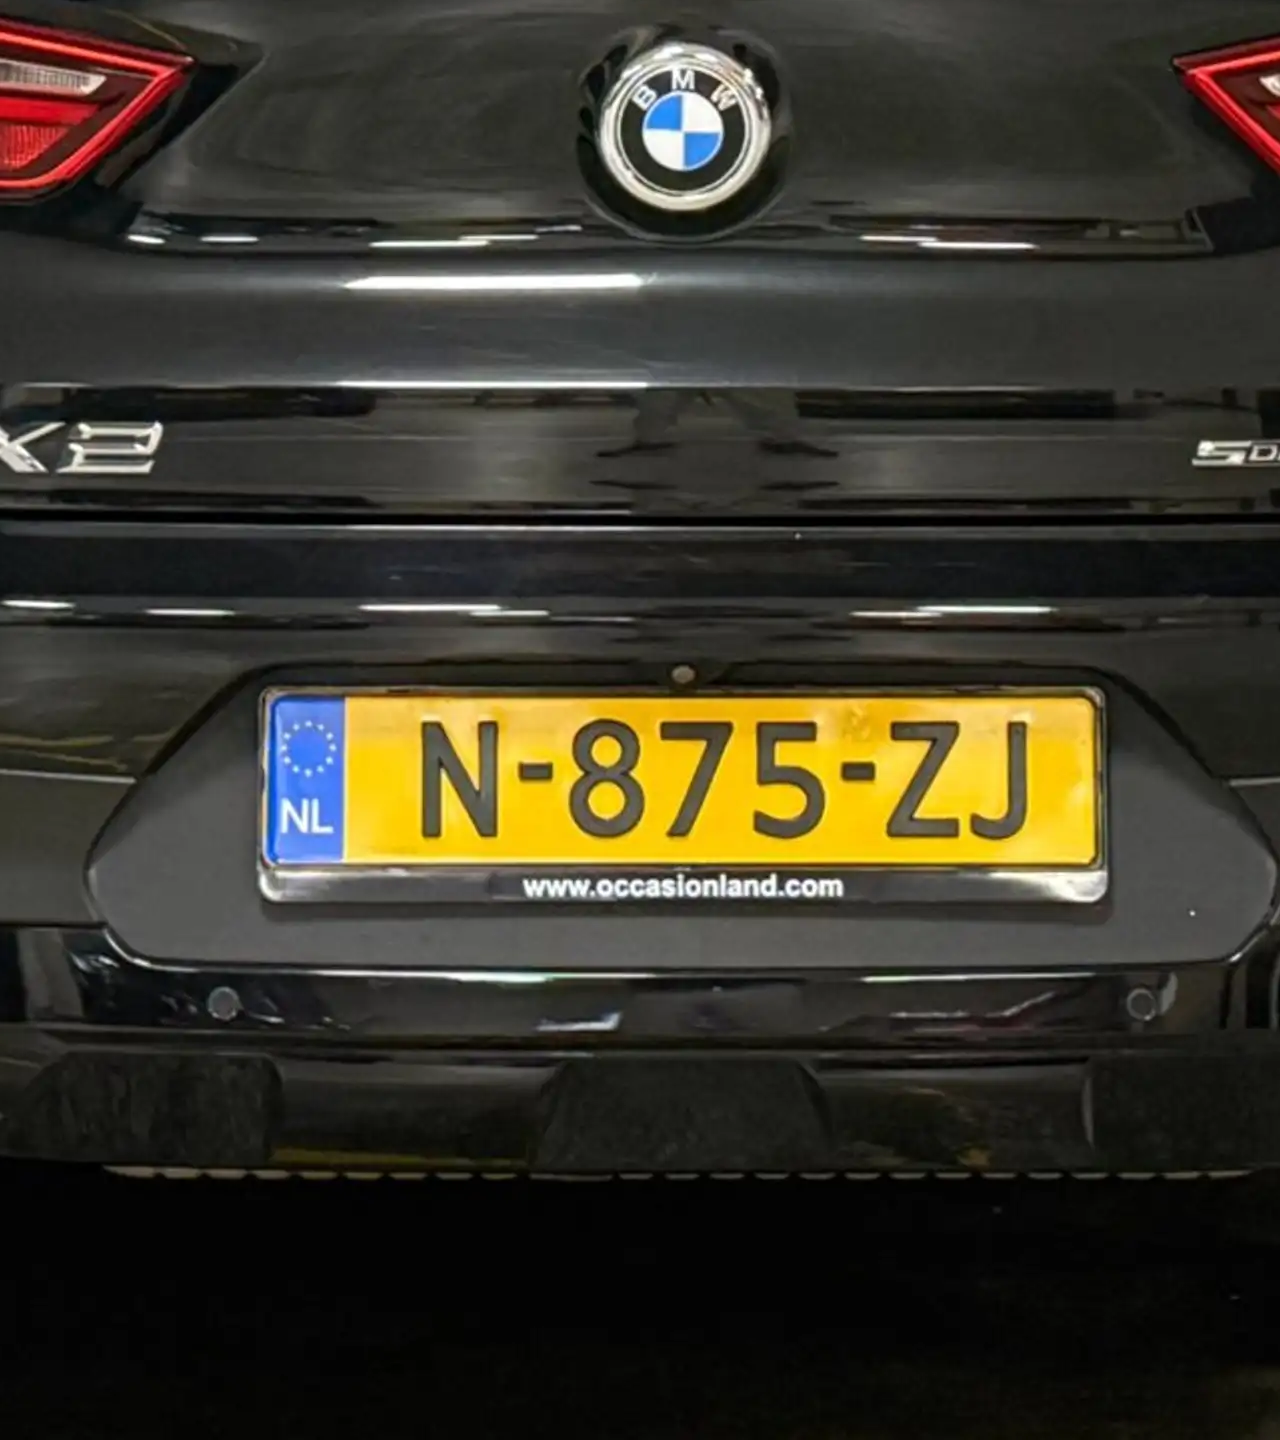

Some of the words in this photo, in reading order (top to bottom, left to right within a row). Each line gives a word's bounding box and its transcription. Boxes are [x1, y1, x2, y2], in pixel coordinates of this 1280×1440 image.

[632, 66, 737, 111] BMW
[421, 718, 1028, 841] N-875-ZJ
[280, 798, 334, 834] NL
[522, 873, 845, 900] www.occasionland.com
